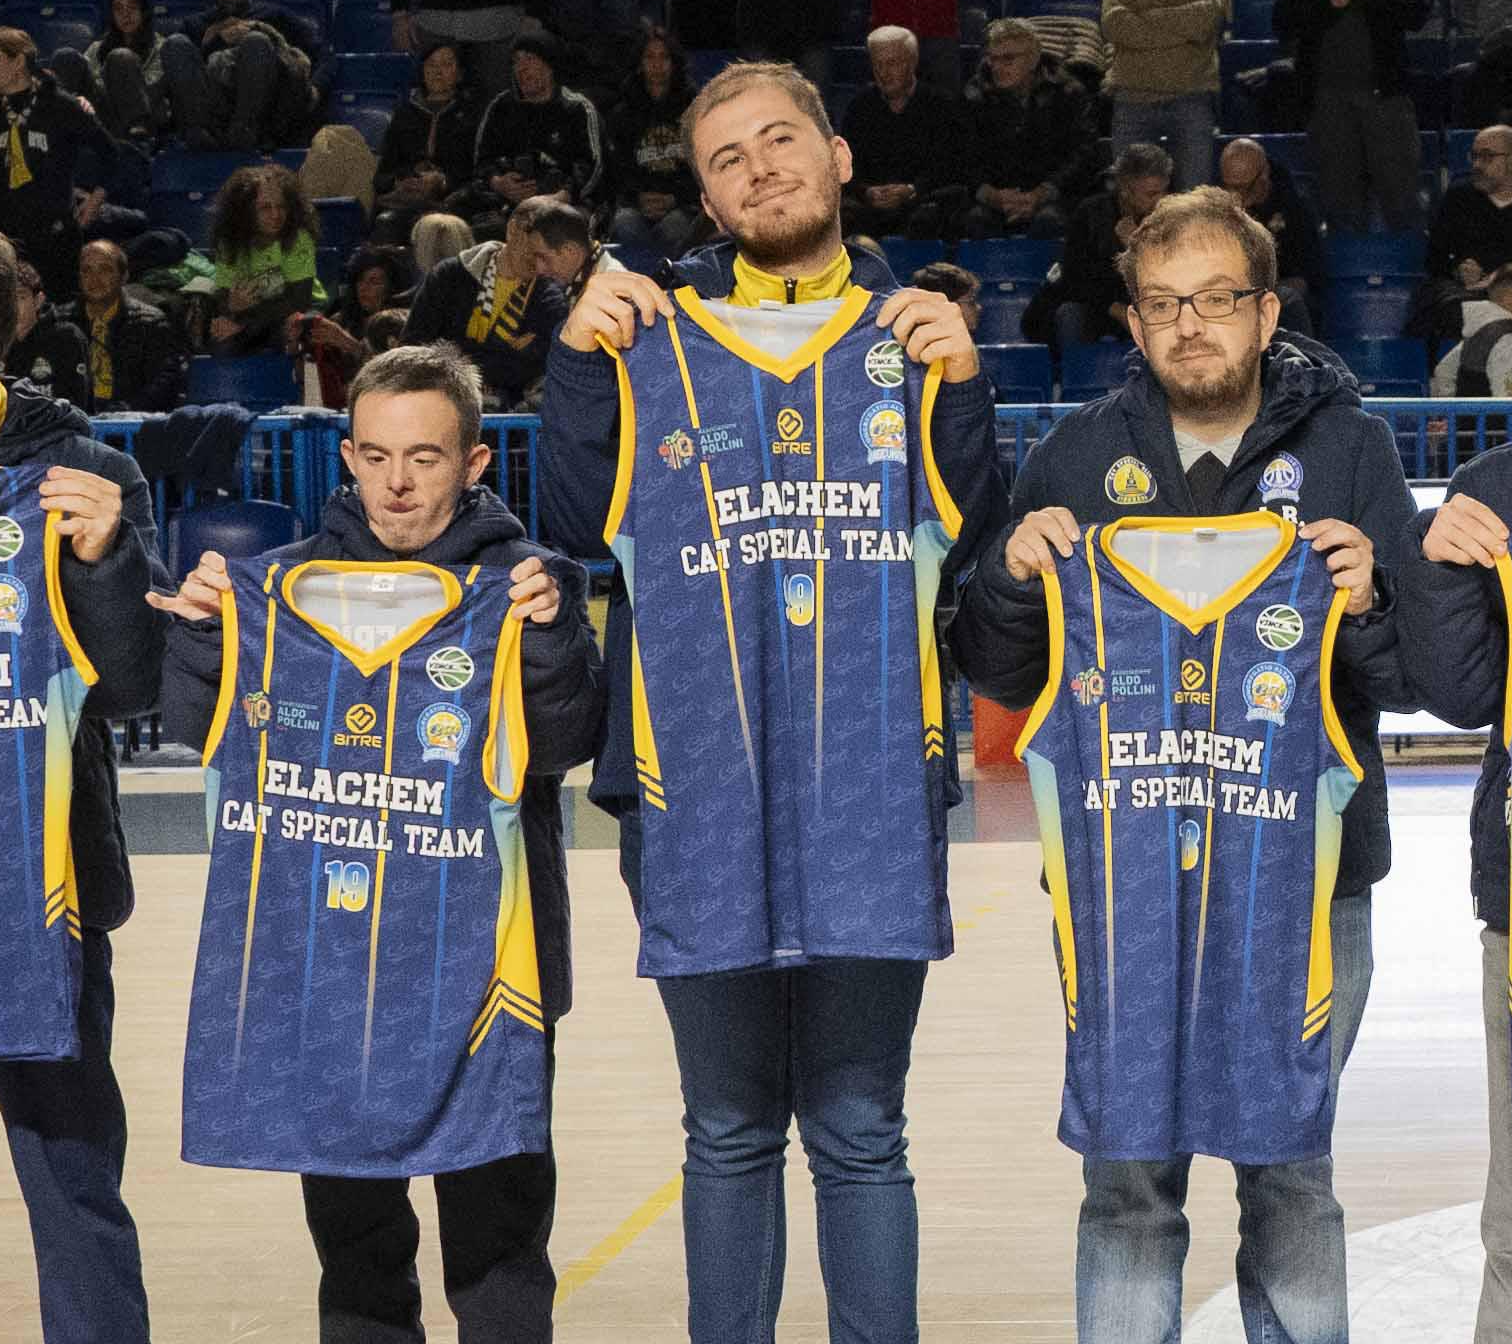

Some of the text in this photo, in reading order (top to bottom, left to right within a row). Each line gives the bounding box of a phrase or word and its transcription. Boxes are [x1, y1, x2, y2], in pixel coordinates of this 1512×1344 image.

[699, 431, 729, 444] ALDO
[701, 438, 744, 455] POLLINI
[772, 442, 812, 455] BTRE
[713, 480, 882, 527] ELACHEM
[680, 528, 914, 577] CAT SPEIAL TEAM
[1111, 676, 1142, 687] ALDO
[1111, 684, 1156, 697] POLLINI
[1174, 691, 1211, 705] BTRE
[276, 707, 308, 718] ALDO
[277, 716, 320, 732] POLLINI
[333, 734, 383, 749] BITRE
[1108, 729, 1265, 775] ELACHEM
[264, 759, 446, 816] ELACHEM
[1082, 778, 1121, 811] AT
[1219, 783, 1298, 821] TEAM
[221, 799, 485, 859] CAT SPECIAL TEAM
[324, 859, 370, 913] 19
